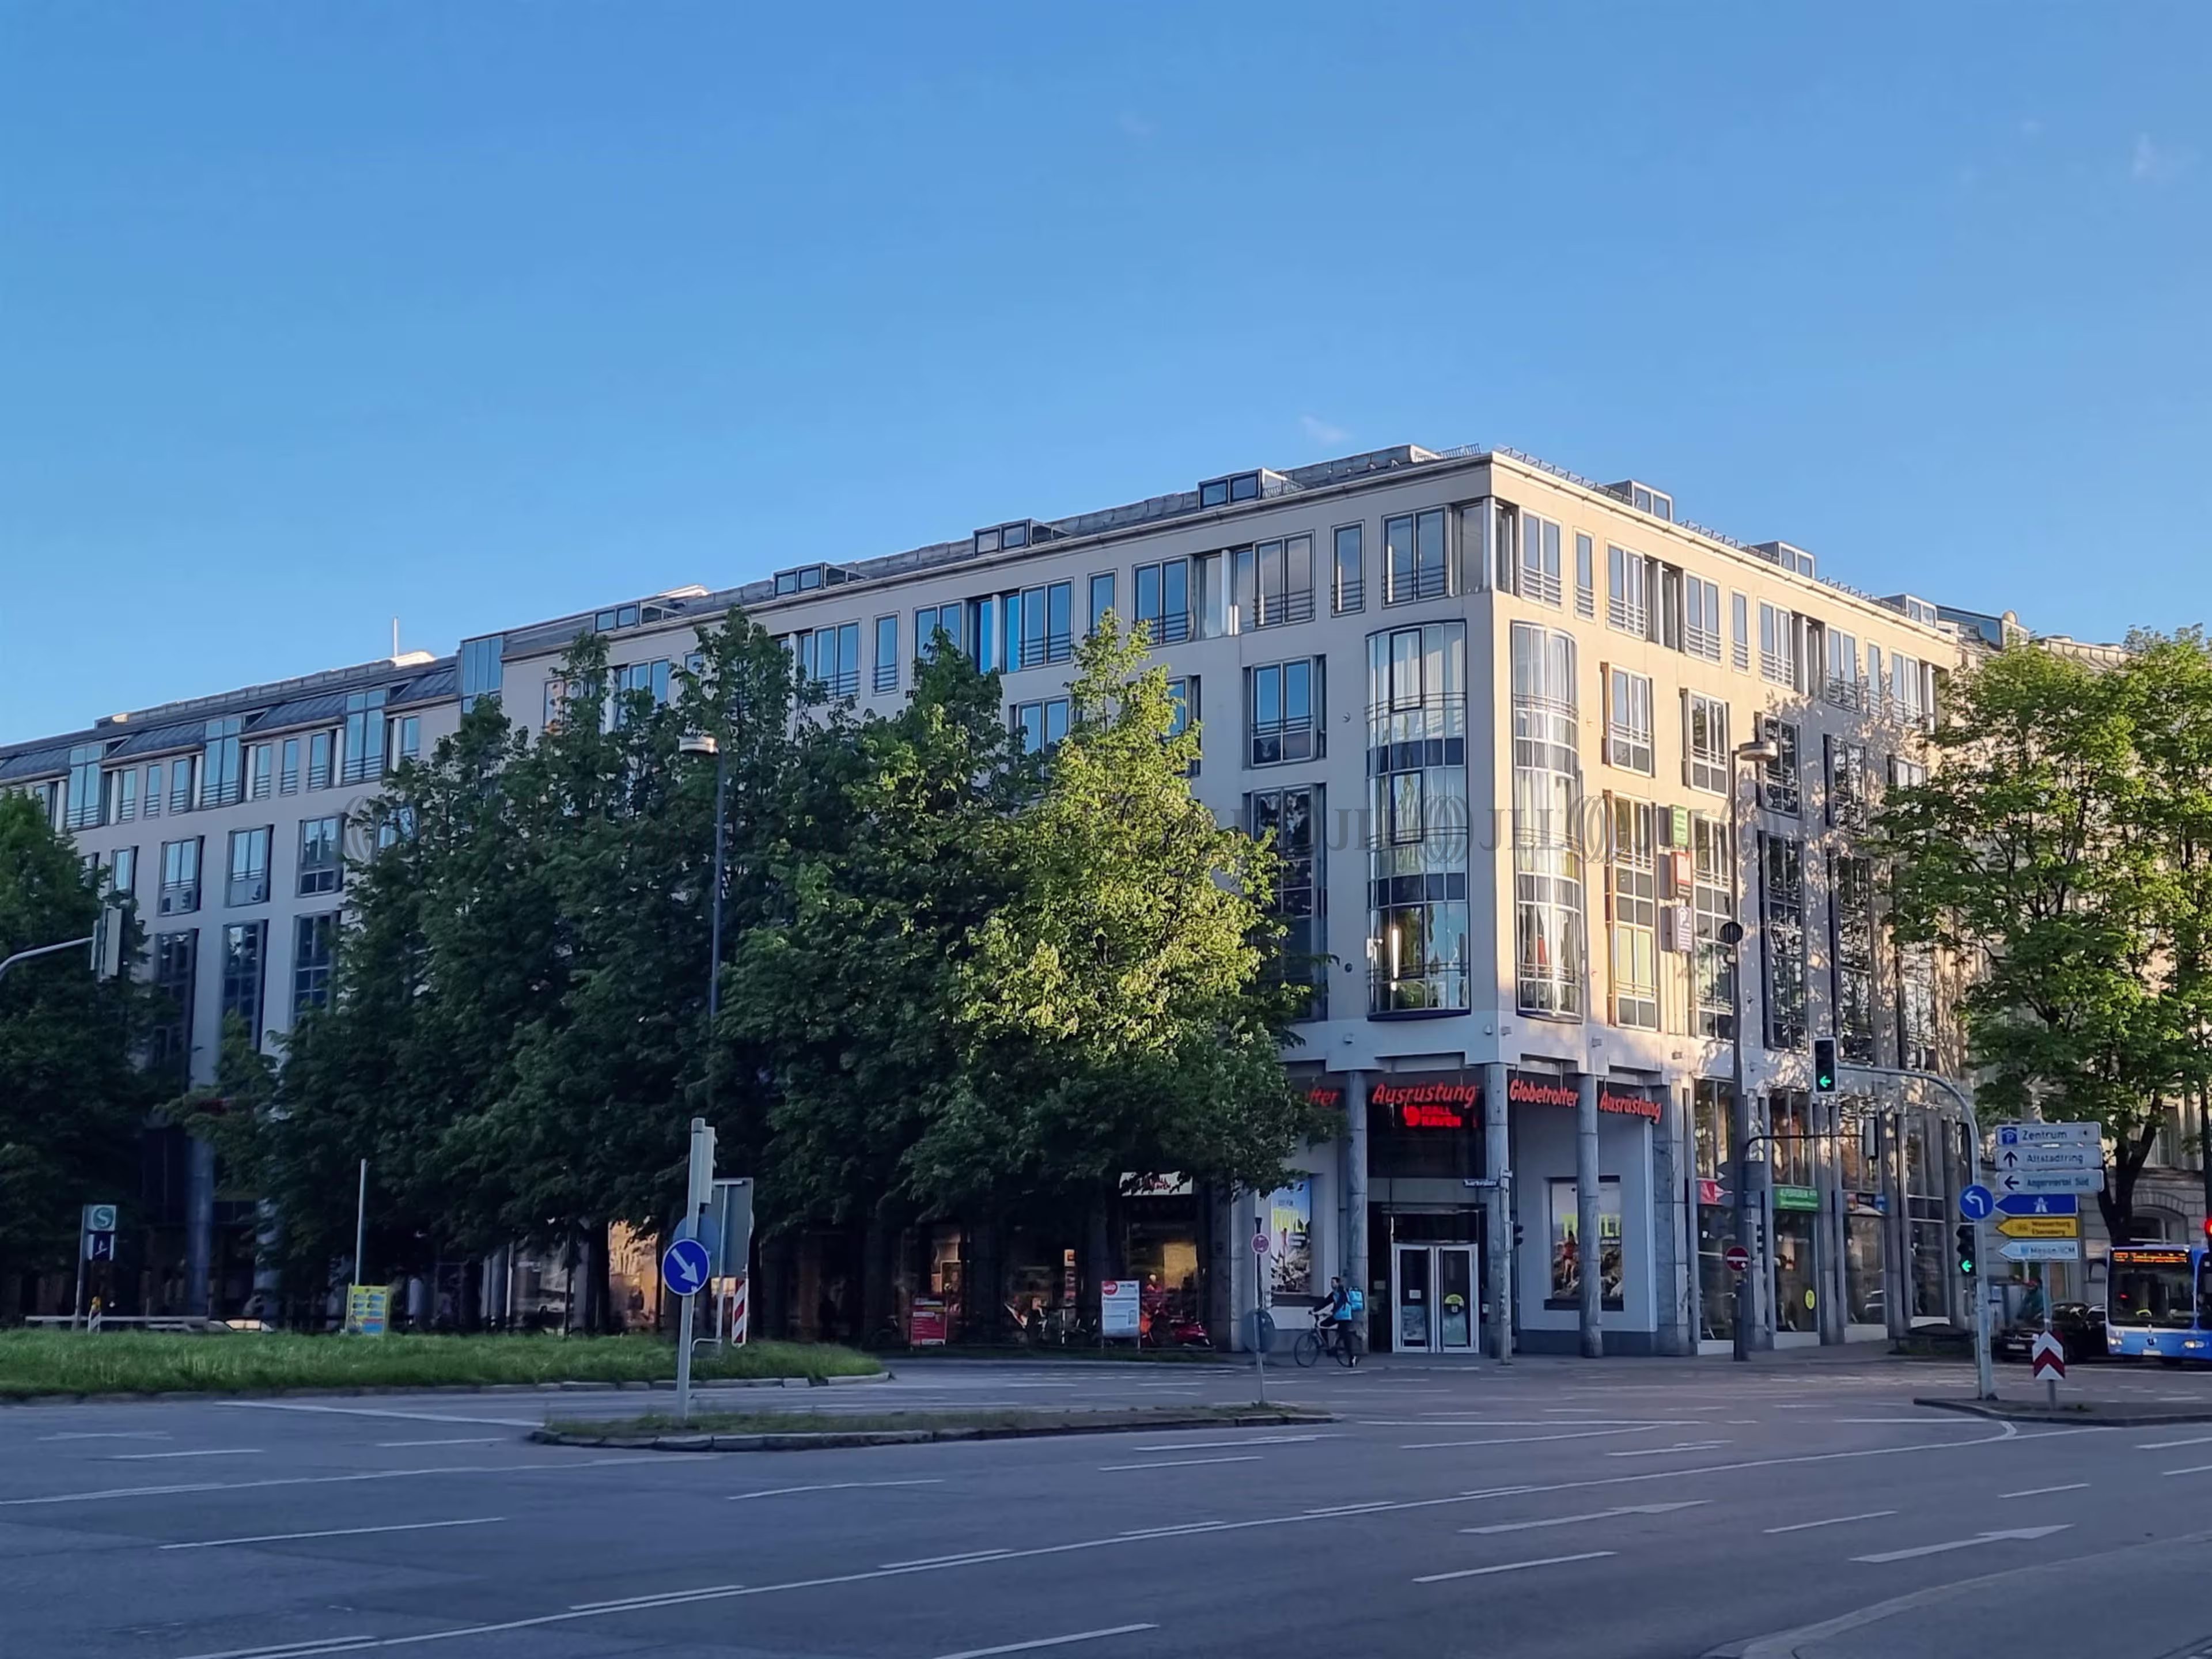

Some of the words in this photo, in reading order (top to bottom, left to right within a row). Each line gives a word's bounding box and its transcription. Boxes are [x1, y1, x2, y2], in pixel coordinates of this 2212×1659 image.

[1372, 1081, 1477, 1109] Ausrüstung
[1509, 1078, 1578, 1107] Globetrotter
[2022, 1130, 2067, 1141] Zentrum
[2027, 1154, 2084, 1164] Altstadtring
